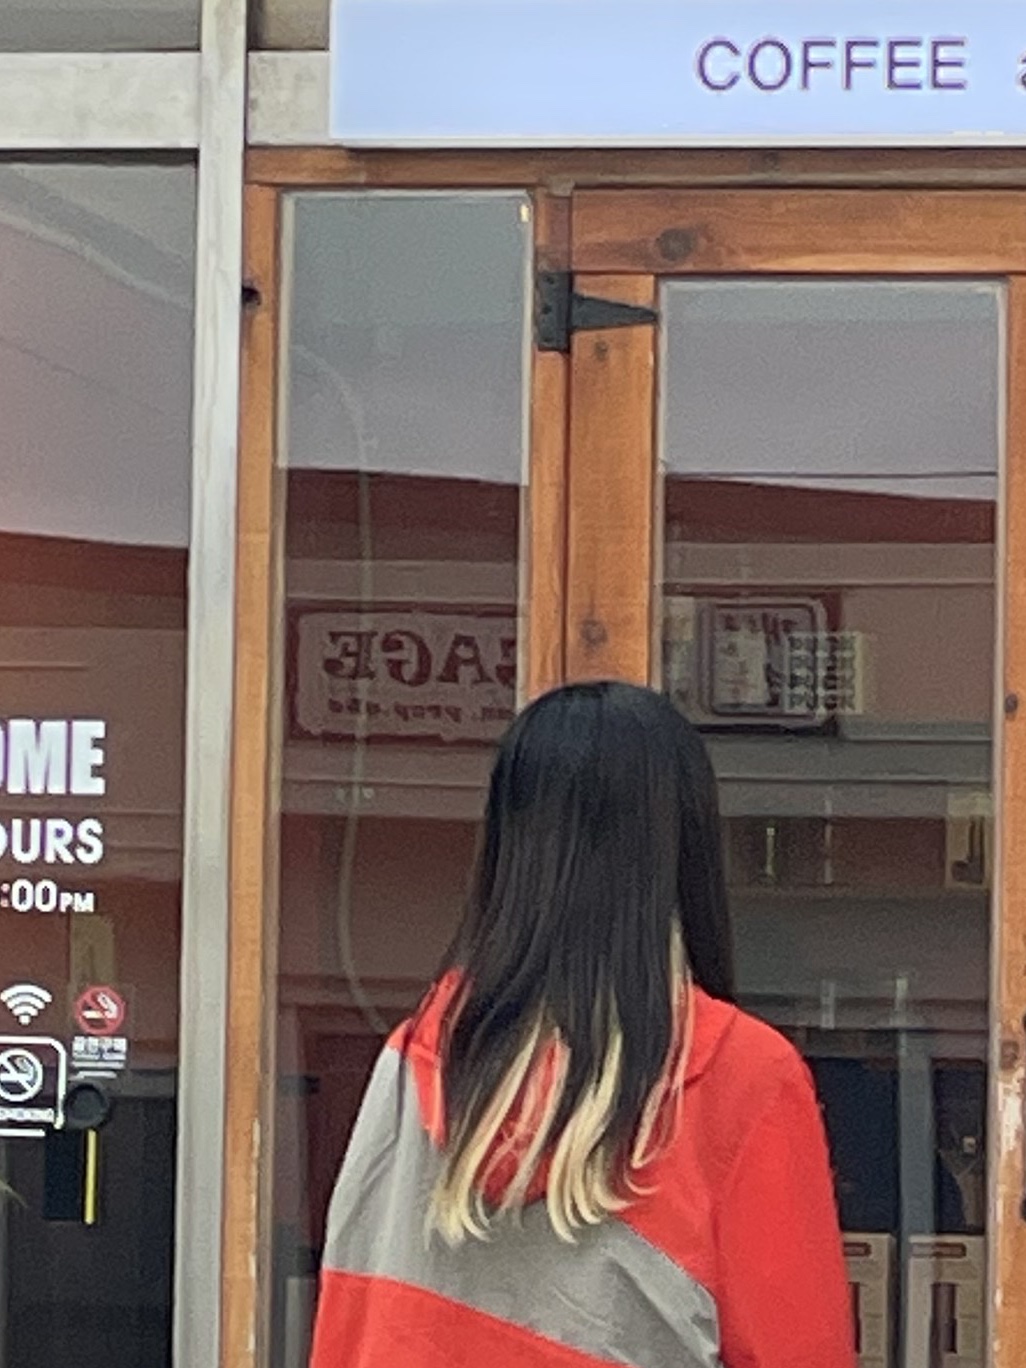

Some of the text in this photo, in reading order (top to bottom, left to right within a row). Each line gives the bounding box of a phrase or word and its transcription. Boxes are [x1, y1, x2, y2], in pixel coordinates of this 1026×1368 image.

[697, 37, 967, 92] COFFEE
[0, 719, 105, 794] ME
[0, 818, 103, 864] URS
